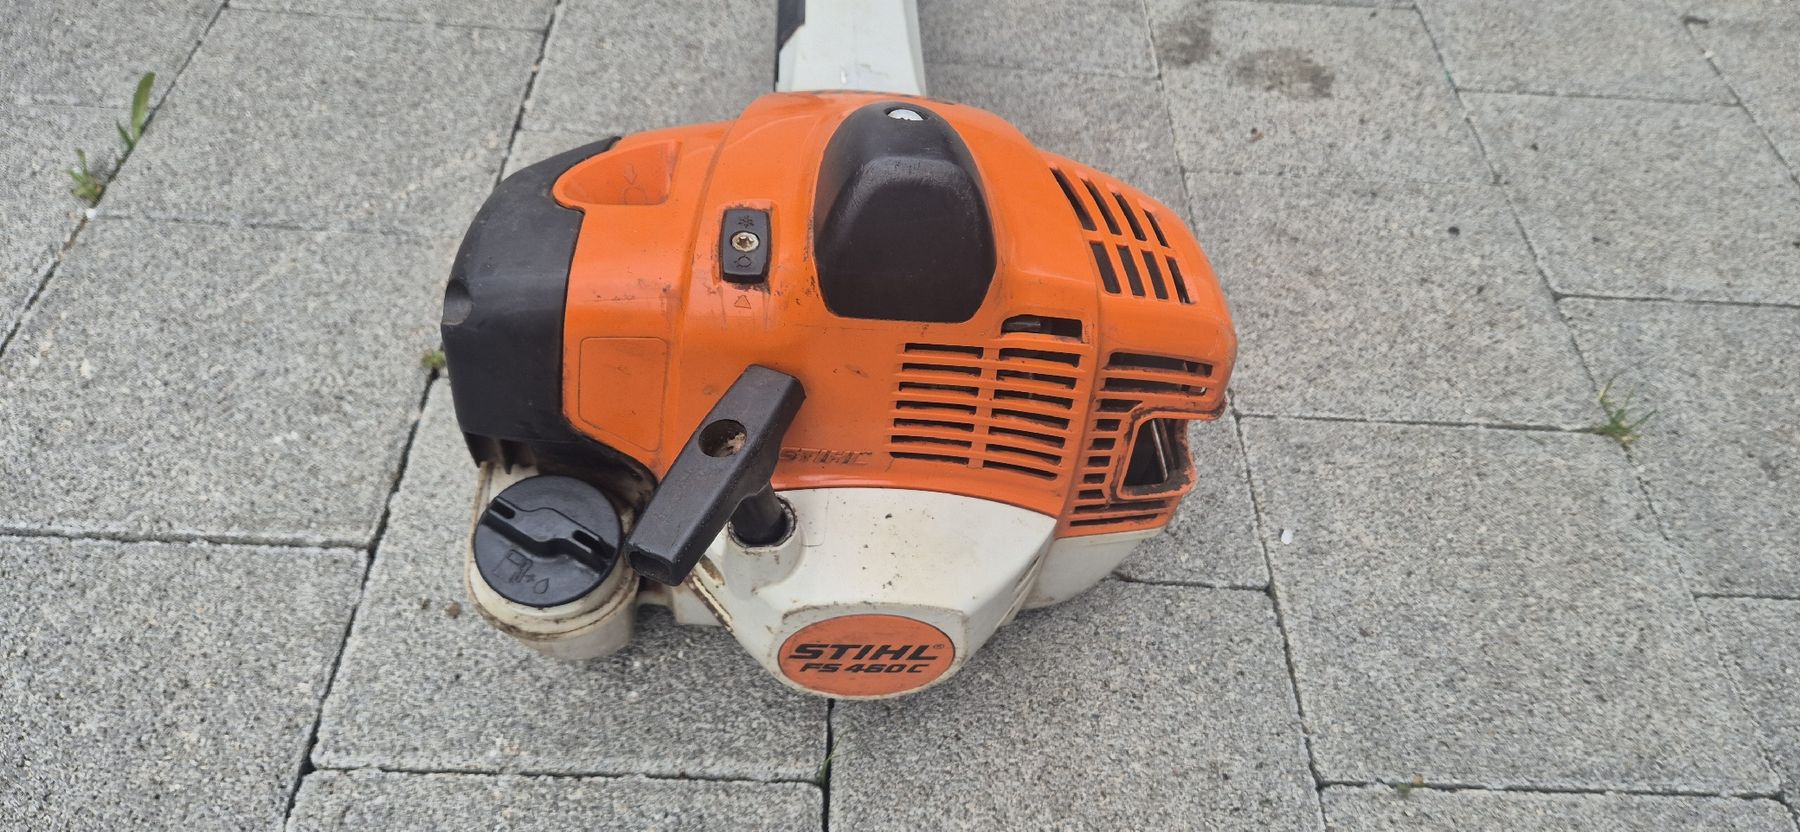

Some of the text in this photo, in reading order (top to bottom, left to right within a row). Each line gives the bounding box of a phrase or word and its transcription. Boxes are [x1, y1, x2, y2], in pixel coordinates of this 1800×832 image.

[788, 643, 938, 661] STIHL
[800, 663, 930, 673] FS 460 C
